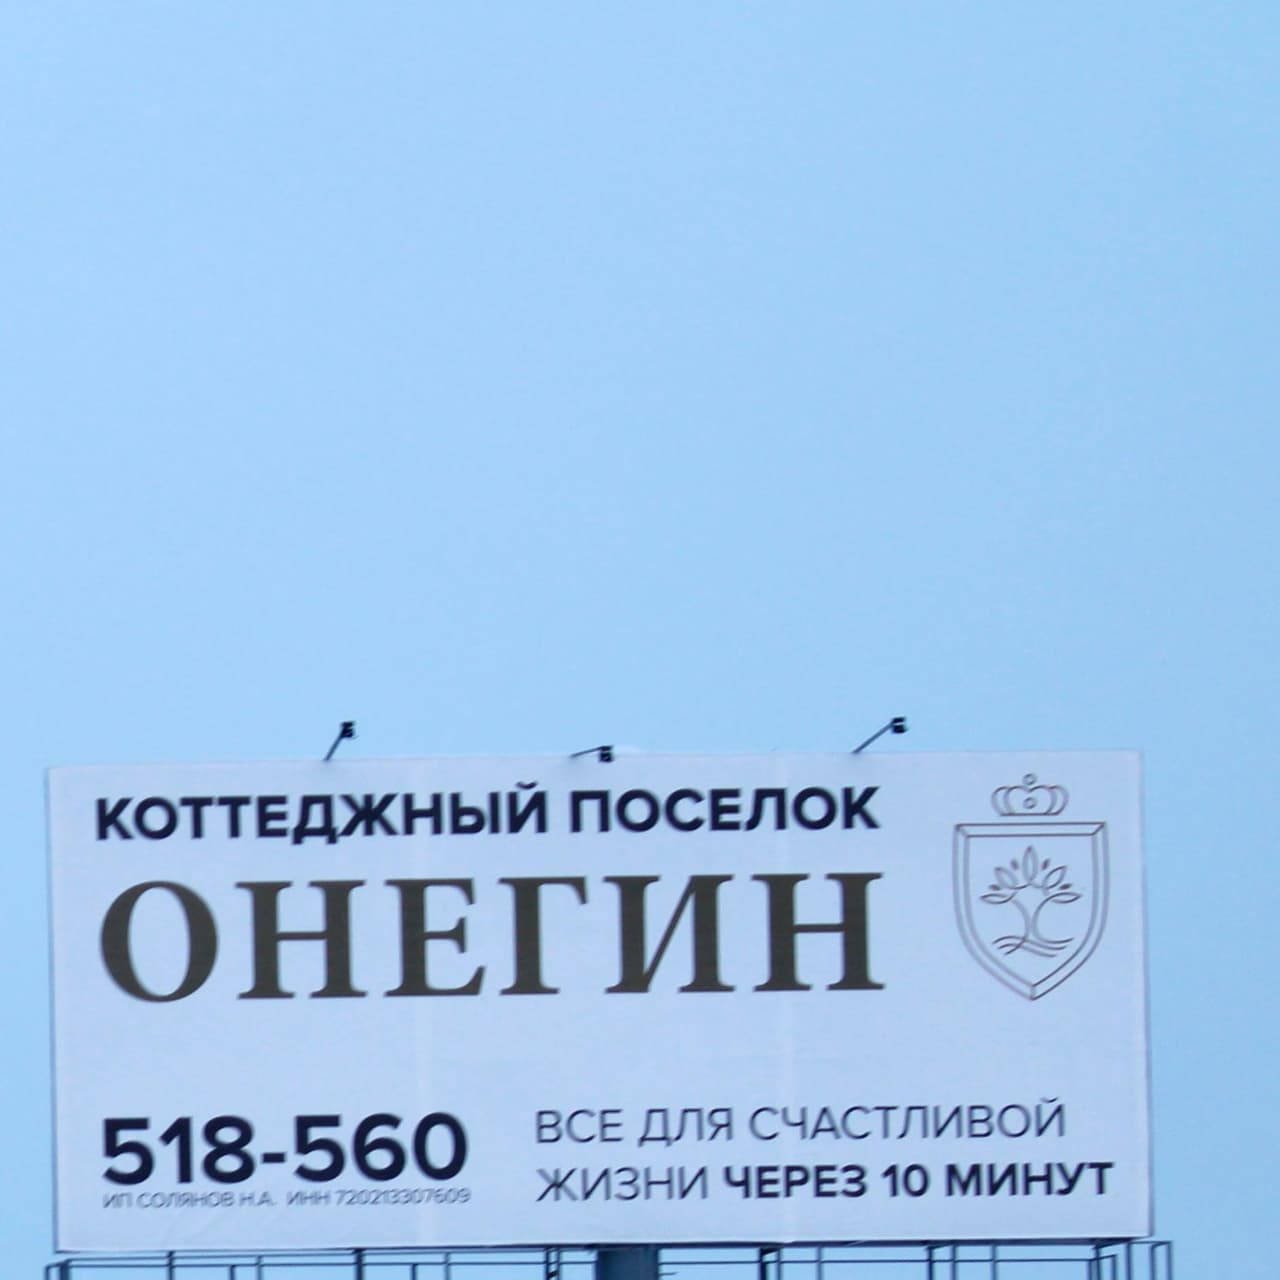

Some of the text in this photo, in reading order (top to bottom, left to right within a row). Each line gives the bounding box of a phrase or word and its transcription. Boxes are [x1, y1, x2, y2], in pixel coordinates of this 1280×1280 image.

[96, 782, 880, 845] КОТТЕДЖНЫЙ ПОСЕЛОК
[101, 872, 885, 1003] ОНЕГИН
[102, 1112, 468, 1186] 518-560
[536, 1097, 1065, 1147] ВСЕ ДЛЯ СЧАСТЛИВОЙ
[103, 1192, 133, 1208] ИП
[136, 1190, 235, 1208] СОЛЯНОВ
[287, 1189, 331, 1206] ИНН
[336, 1187, 472, 1205] 720213307609
[536, 1161, 1115, 1202] ЖИЗНИ ЧЕРЕЗ 10 МИНУТ
